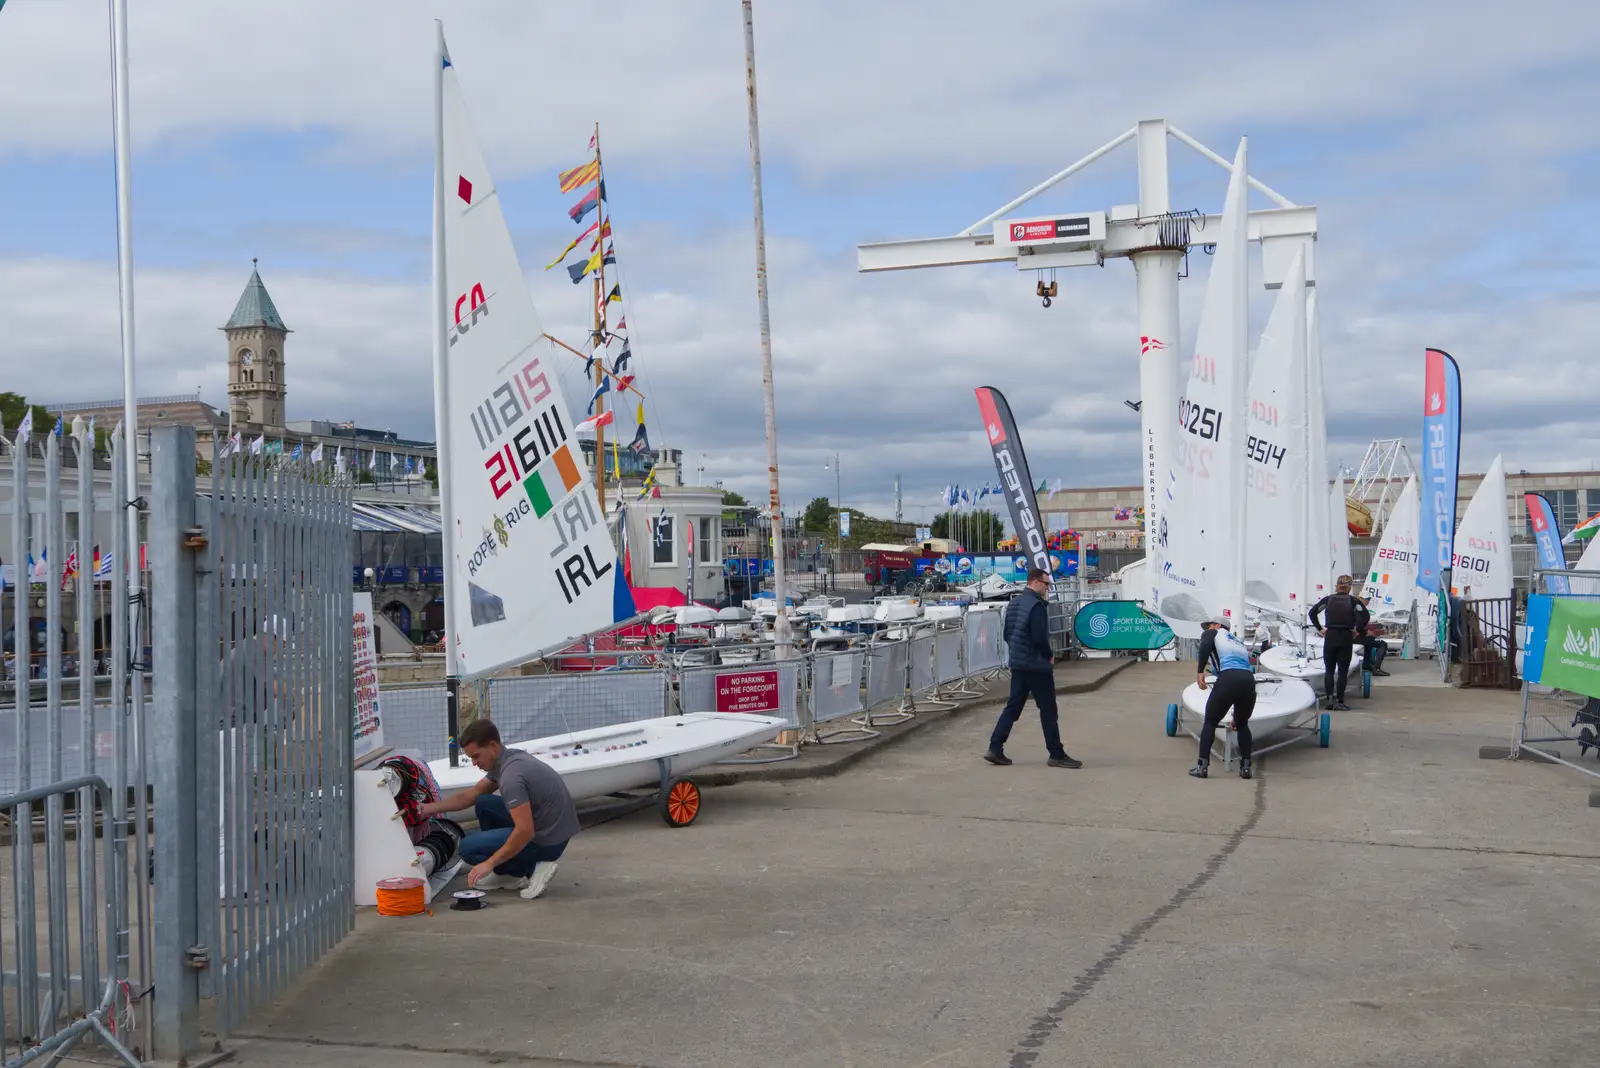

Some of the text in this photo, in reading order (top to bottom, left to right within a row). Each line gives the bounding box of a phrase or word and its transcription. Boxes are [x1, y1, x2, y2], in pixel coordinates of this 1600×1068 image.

[450, 282, 489, 347] CA
[484, 404, 567, 500] 216111
[468, 499, 531, 576] ROPE RIG
[555, 544, 612, 604] IRL
[720, 683, 776, 695] ON THE FORECOURT
[731, 675, 765, 685] NO PARKING
[738, 702, 757, 710] MINUTES
